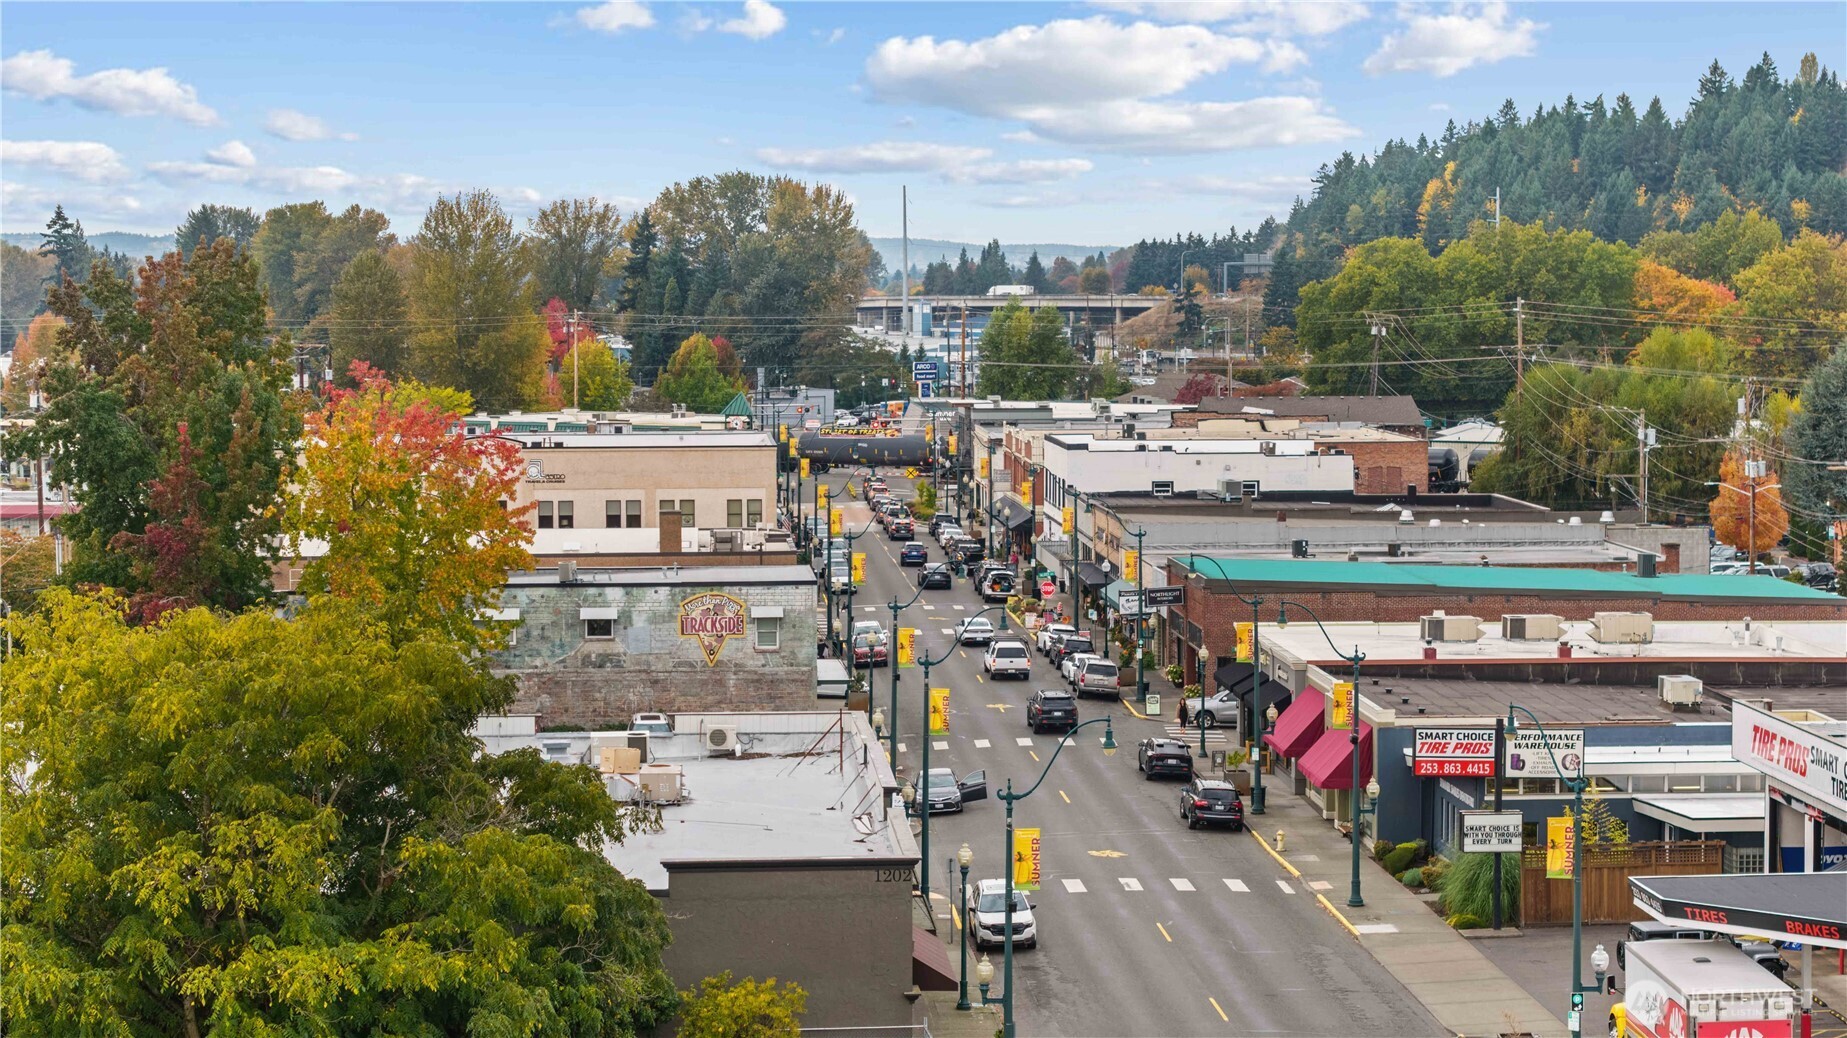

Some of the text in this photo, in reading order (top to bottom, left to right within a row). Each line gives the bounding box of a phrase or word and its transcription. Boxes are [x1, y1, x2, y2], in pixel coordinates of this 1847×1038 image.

[682, 616, 742, 634] TRACKSIDE
[1418, 732, 1494, 741] SMART CHOICE
[1418, 742, 1492, 754] TIRE PROS
[1751, 724, 1778, 763] TIRE
[1776, 736, 1810, 778] PROS
[1810, 745, 1839, 774] SMART
[1420, 763, 1490, 774] 253.863.4415
[1565, 827, 1574, 875] SUMNER
[1032, 838, 1040, 886] SUMNER
[875, 869, 911, 882] 1202
[1684, 907, 1728, 924] TIRES
[1785, 920, 1840, 939] BRAKES
